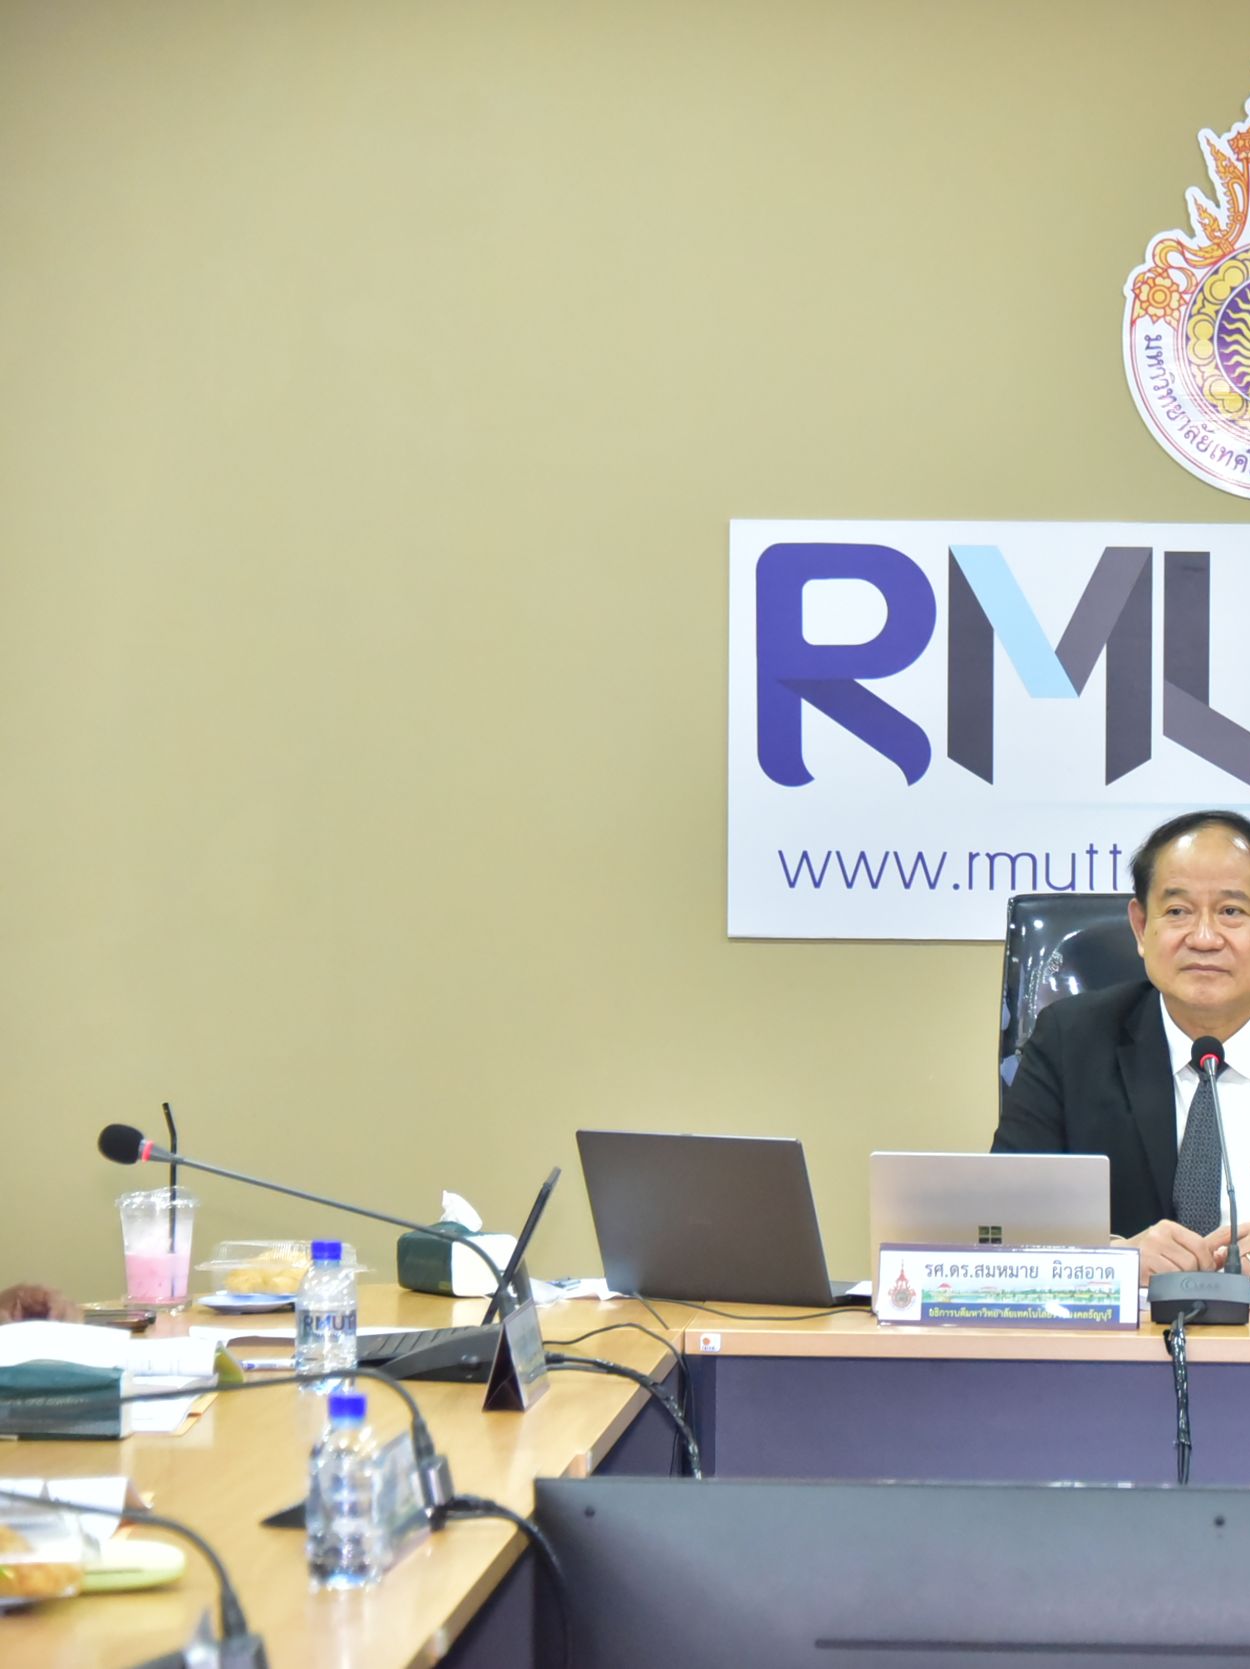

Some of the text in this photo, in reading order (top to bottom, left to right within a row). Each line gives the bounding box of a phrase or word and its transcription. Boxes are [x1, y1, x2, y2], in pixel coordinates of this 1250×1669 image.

[924, 1259, 1115, 1280] รศ.ดร.สมหมาย ผิวสอาด
